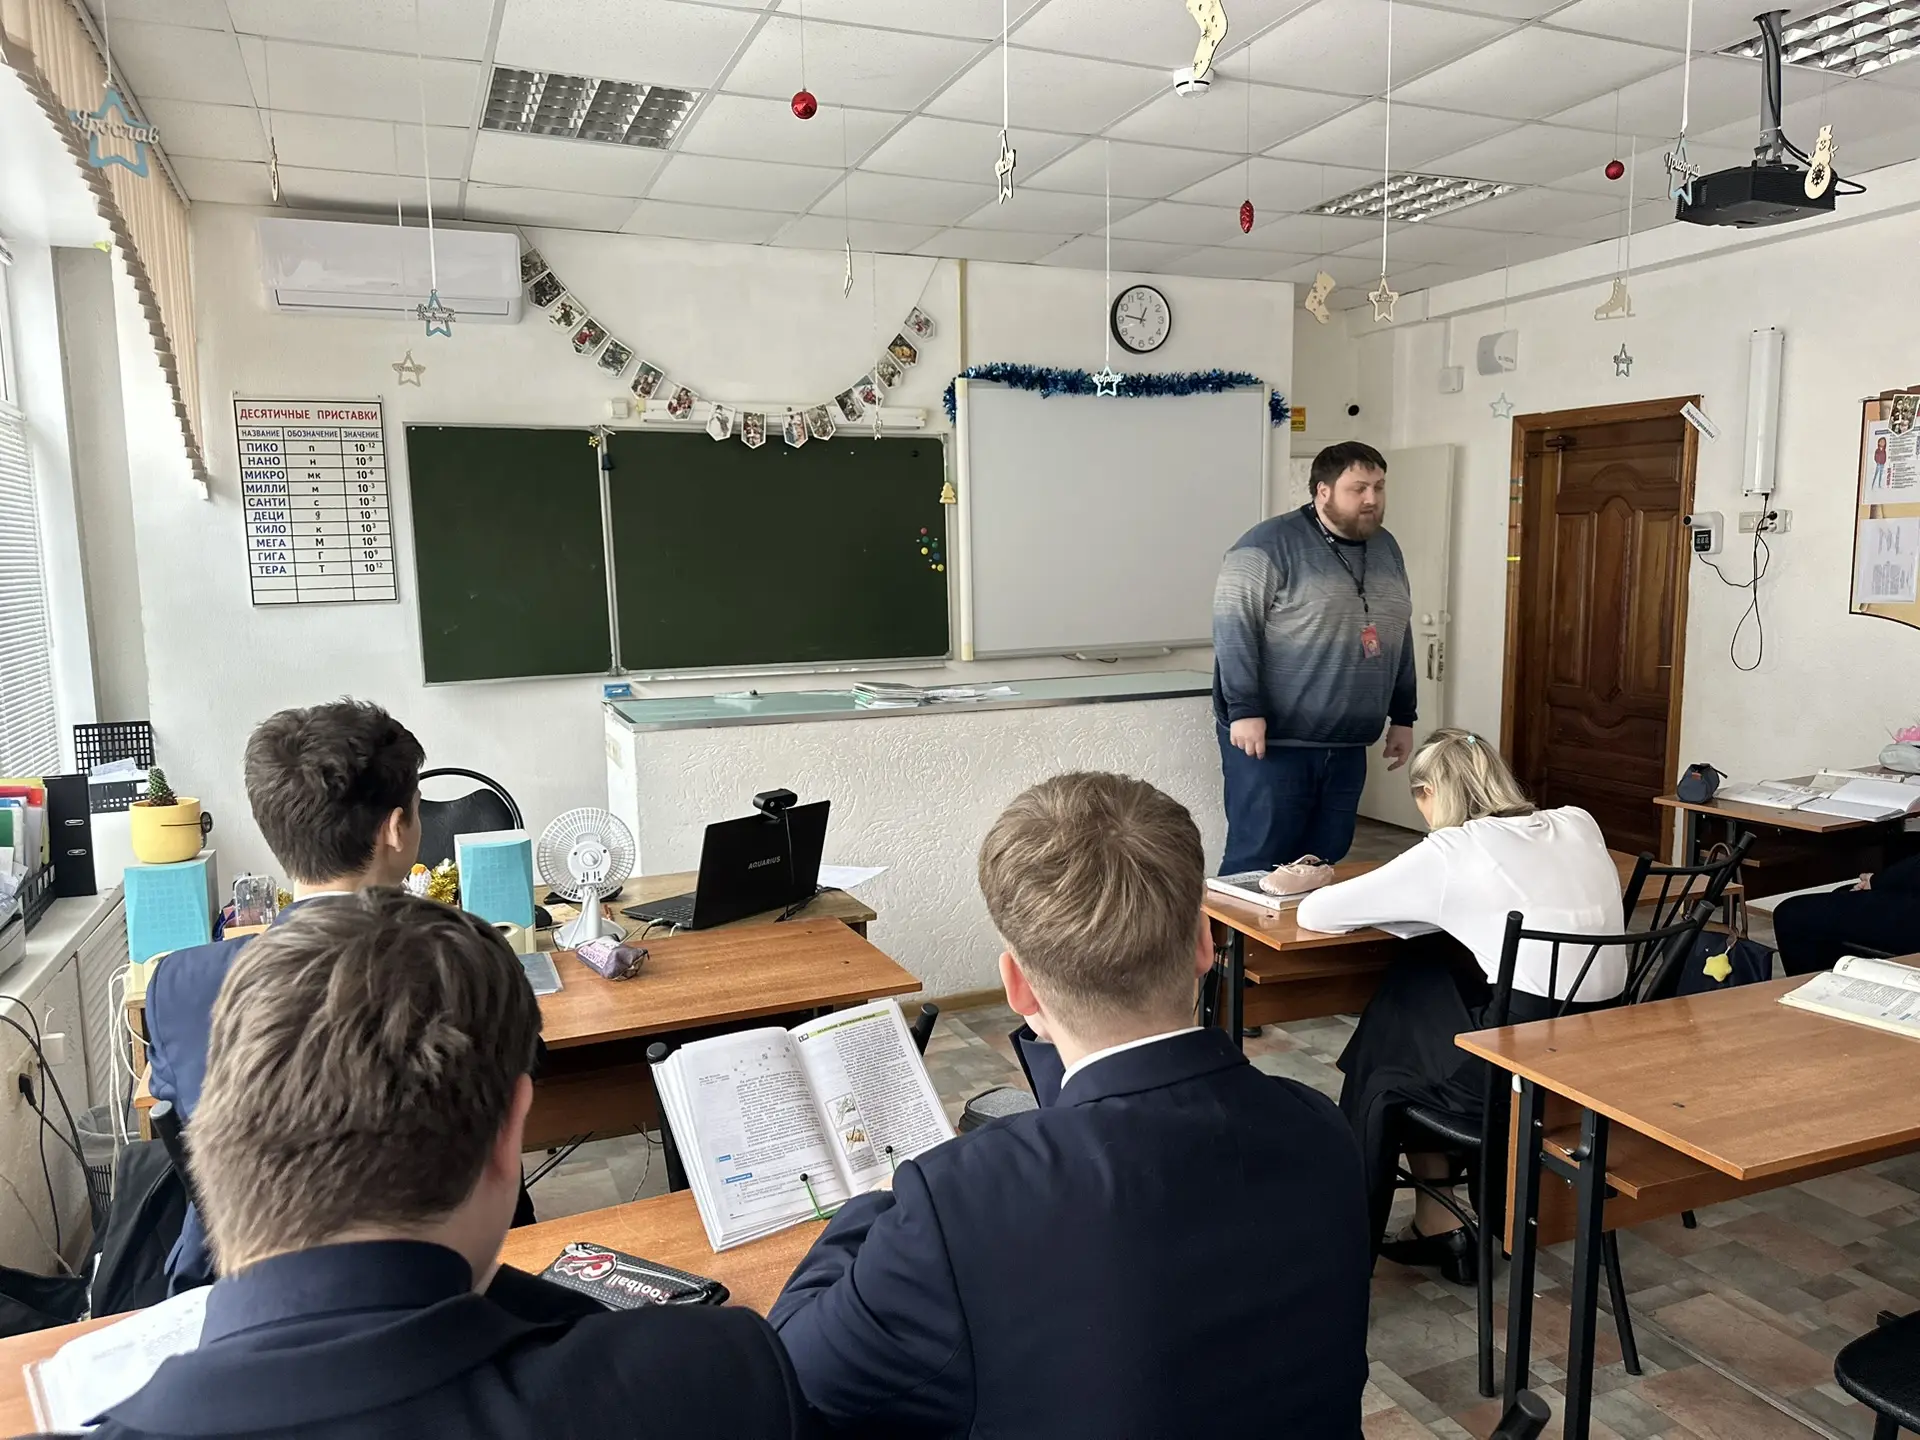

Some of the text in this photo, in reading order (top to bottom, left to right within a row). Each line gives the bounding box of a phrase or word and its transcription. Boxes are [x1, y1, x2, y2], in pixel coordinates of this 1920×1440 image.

[1127, 295, 1134, 303] 11
[1136, 292, 1145, 301] 12
[1120, 303, 1129, 312] 10
[1154, 304, 1161, 313] 2
[1118, 316, 1124, 324] 9
[1157, 316, 1164, 325] 3
[1121, 328, 1128, 336] 8
[1155, 328, 1161, 336] 4
[1129, 336, 1135, 345] 7
[1138, 340, 1145, 348] 6
[1148, 336, 1155, 345] 5
[239, 408, 378, 421] ДЕСЯТИЧНЫЕ ПРИСТАВКИ
[241, 429, 380, 439] НАЗВАНИЕ ОБОЗНАЧЕНИЕ ЗНАЧЕНИЕ
[246, 442, 279, 453] ПИКО
[247, 456, 281, 466] НАНО
[244, 470, 286, 480] МИКРО
[245, 483, 287, 494] МИЛЛИ
[247, 497, 287, 508] САНТИ
[253, 510, 285, 522] ДЕЦИ
[255, 524, 287, 534] КИЛО
[256, 538, 287, 548] МЕГА
[257, 551, 287, 562] ГИГА
[258, 565, 288, 575] ТЕРА
[748, 855, 781, 870] AQUARIUS
[605, 1273, 670, 1305] Football
